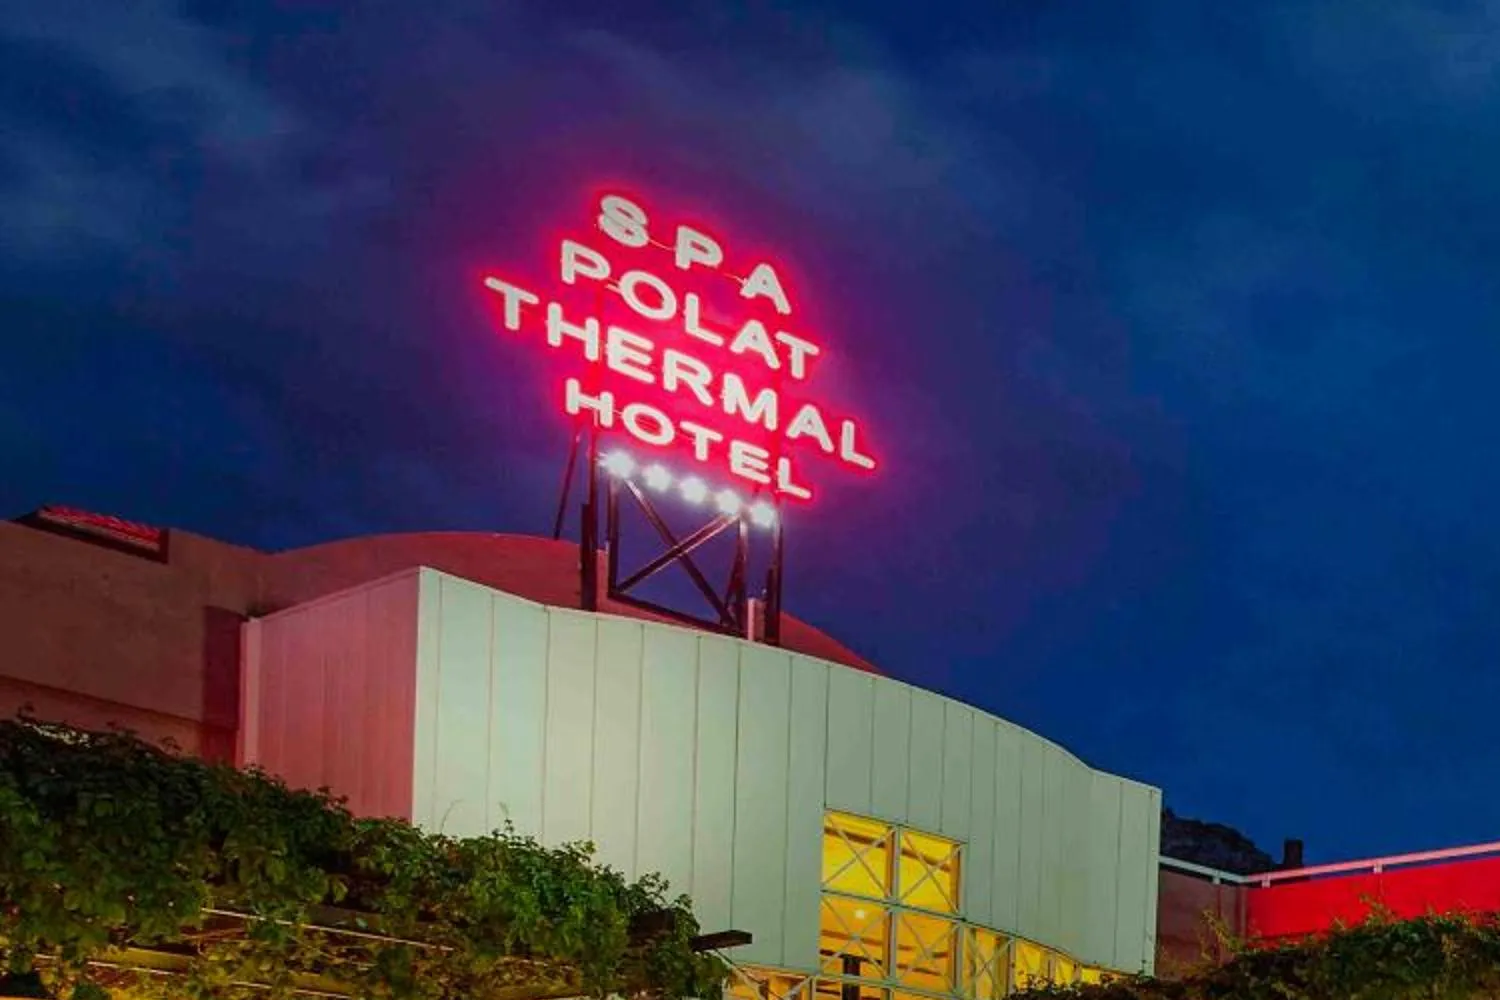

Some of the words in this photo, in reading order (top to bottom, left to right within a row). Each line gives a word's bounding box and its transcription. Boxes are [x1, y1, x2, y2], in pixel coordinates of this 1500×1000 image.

[561, 239, 820, 379] POLAT
[598, 195, 791, 315] SPA
[484, 276, 876, 469] THERMAL
[565, 378, 812, 499] HOTEL
